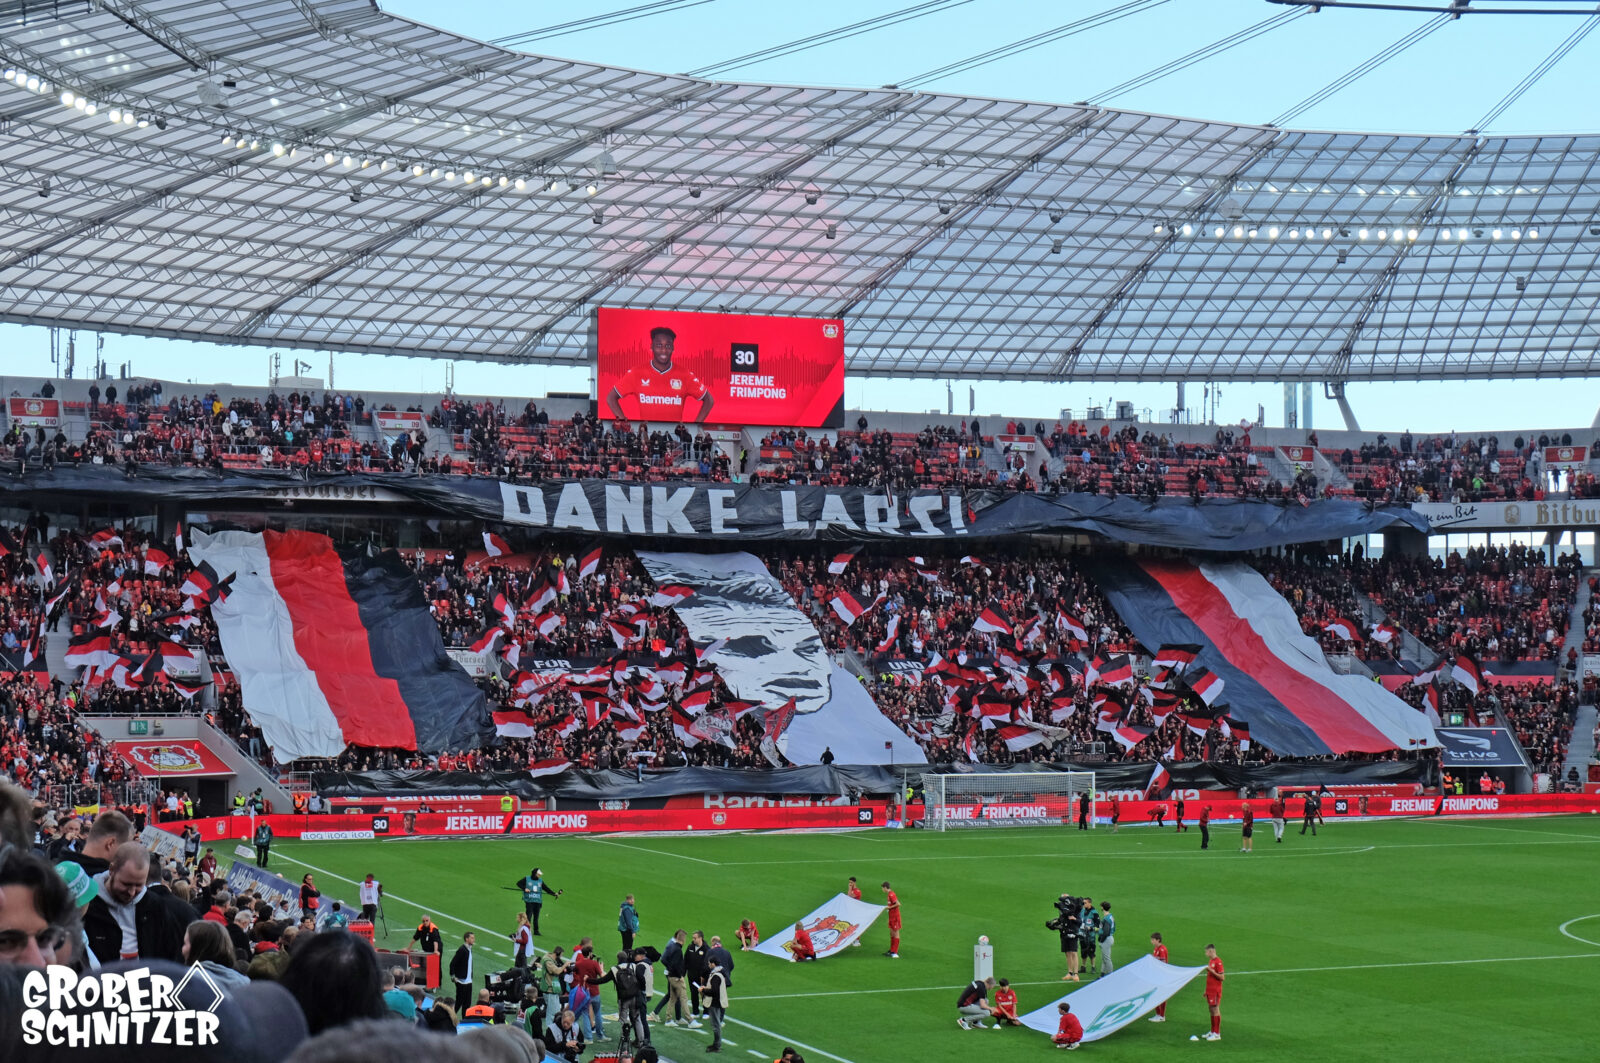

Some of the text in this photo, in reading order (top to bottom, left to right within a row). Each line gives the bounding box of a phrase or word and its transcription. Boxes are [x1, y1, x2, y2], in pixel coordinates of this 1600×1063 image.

[735, 350, 755, 365] 30
[730, 374, 774, 386] JEREMIE
[639, 393, 682, 405] Barmenia
[730, 387, 787, 399] FRIMPONG
[499, 481, 740, 534] DANKE
[1455, 505, 1478, 518] Bit
[1536, 503, 1600, 525] Bitbu
[1335, 801, 1347, 812] 30
[1390, 798, 1498, 812] JEREMIE FRIMPONG
[859, 811, 872, 822] 30
[982, 806, 1047, 819] FRIMPONG
[373, 819, 388, 830] 30
[445, 814, 587, 830] JEREMIE FRIMPONG
